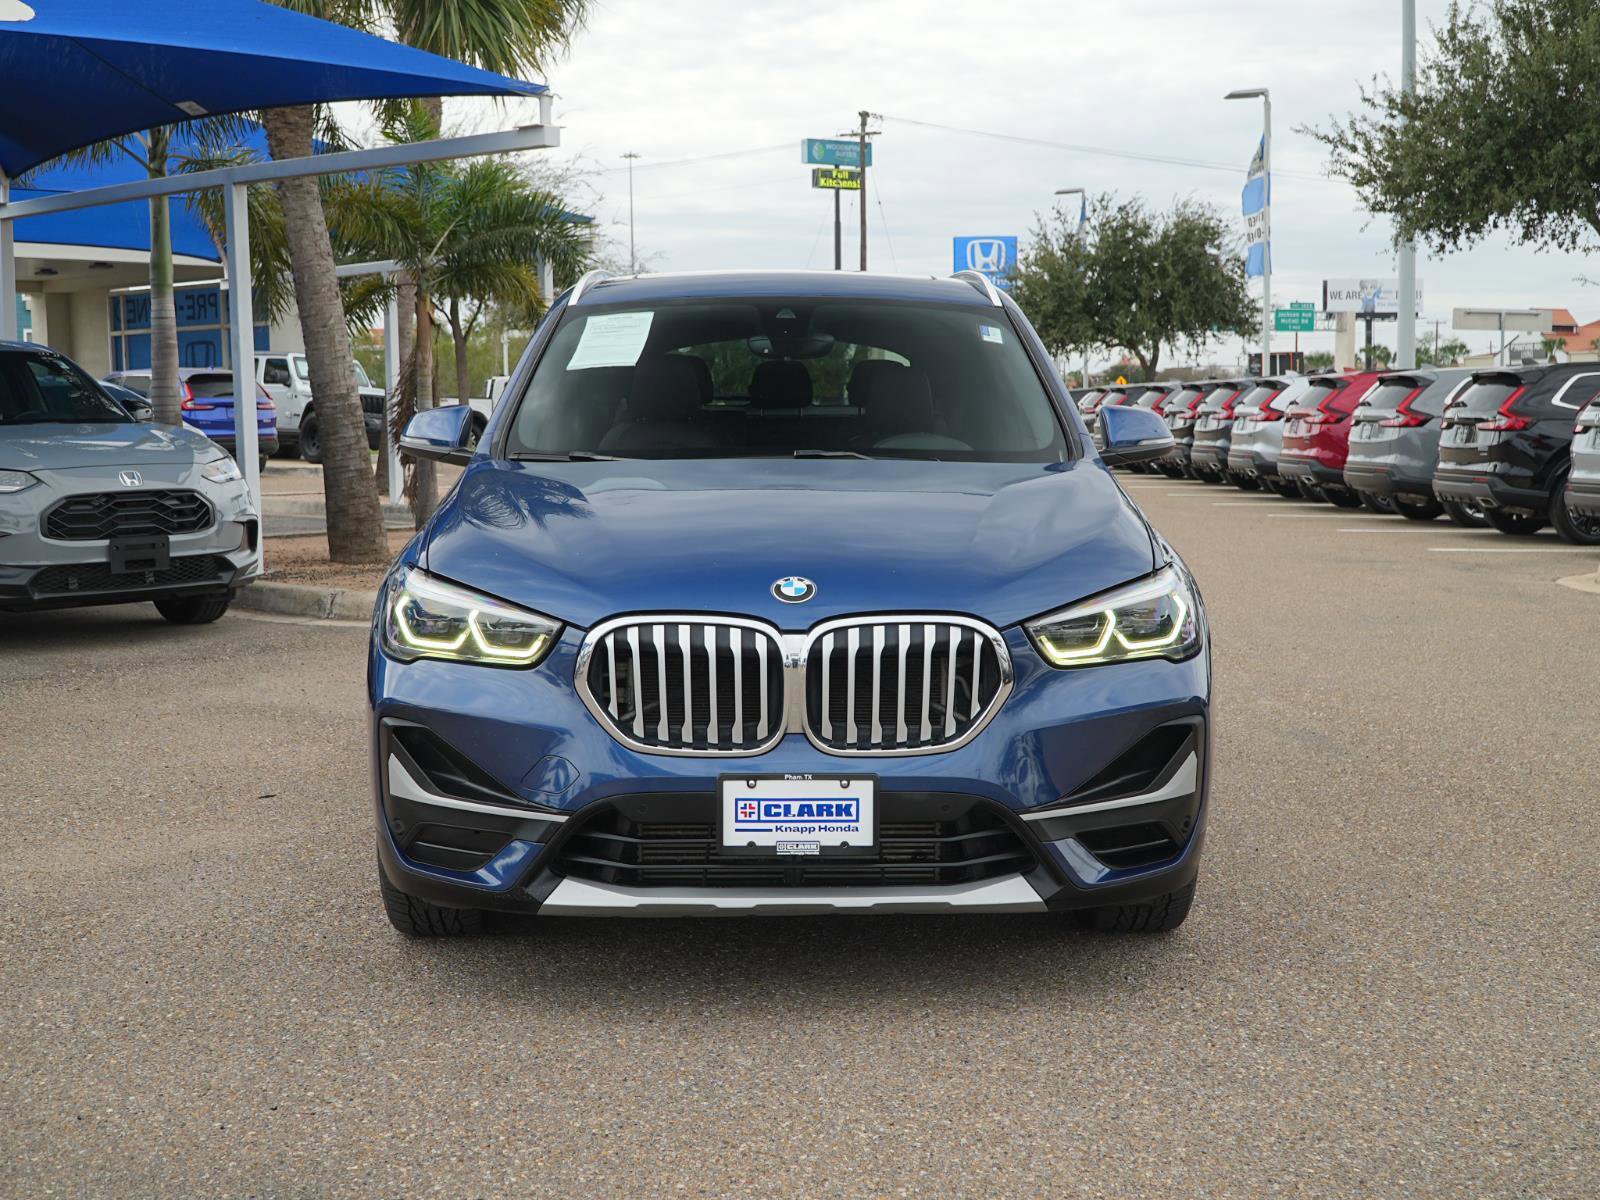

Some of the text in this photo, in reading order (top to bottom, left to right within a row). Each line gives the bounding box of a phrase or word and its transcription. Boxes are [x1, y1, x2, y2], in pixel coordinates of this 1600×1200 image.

[832, 170, 849, 179] Full
[1329, 290, 1362, 300] WE ARE
[763, 803, 853, 818] CLARK
[775, 825, 859, 834] Knapp Honda
